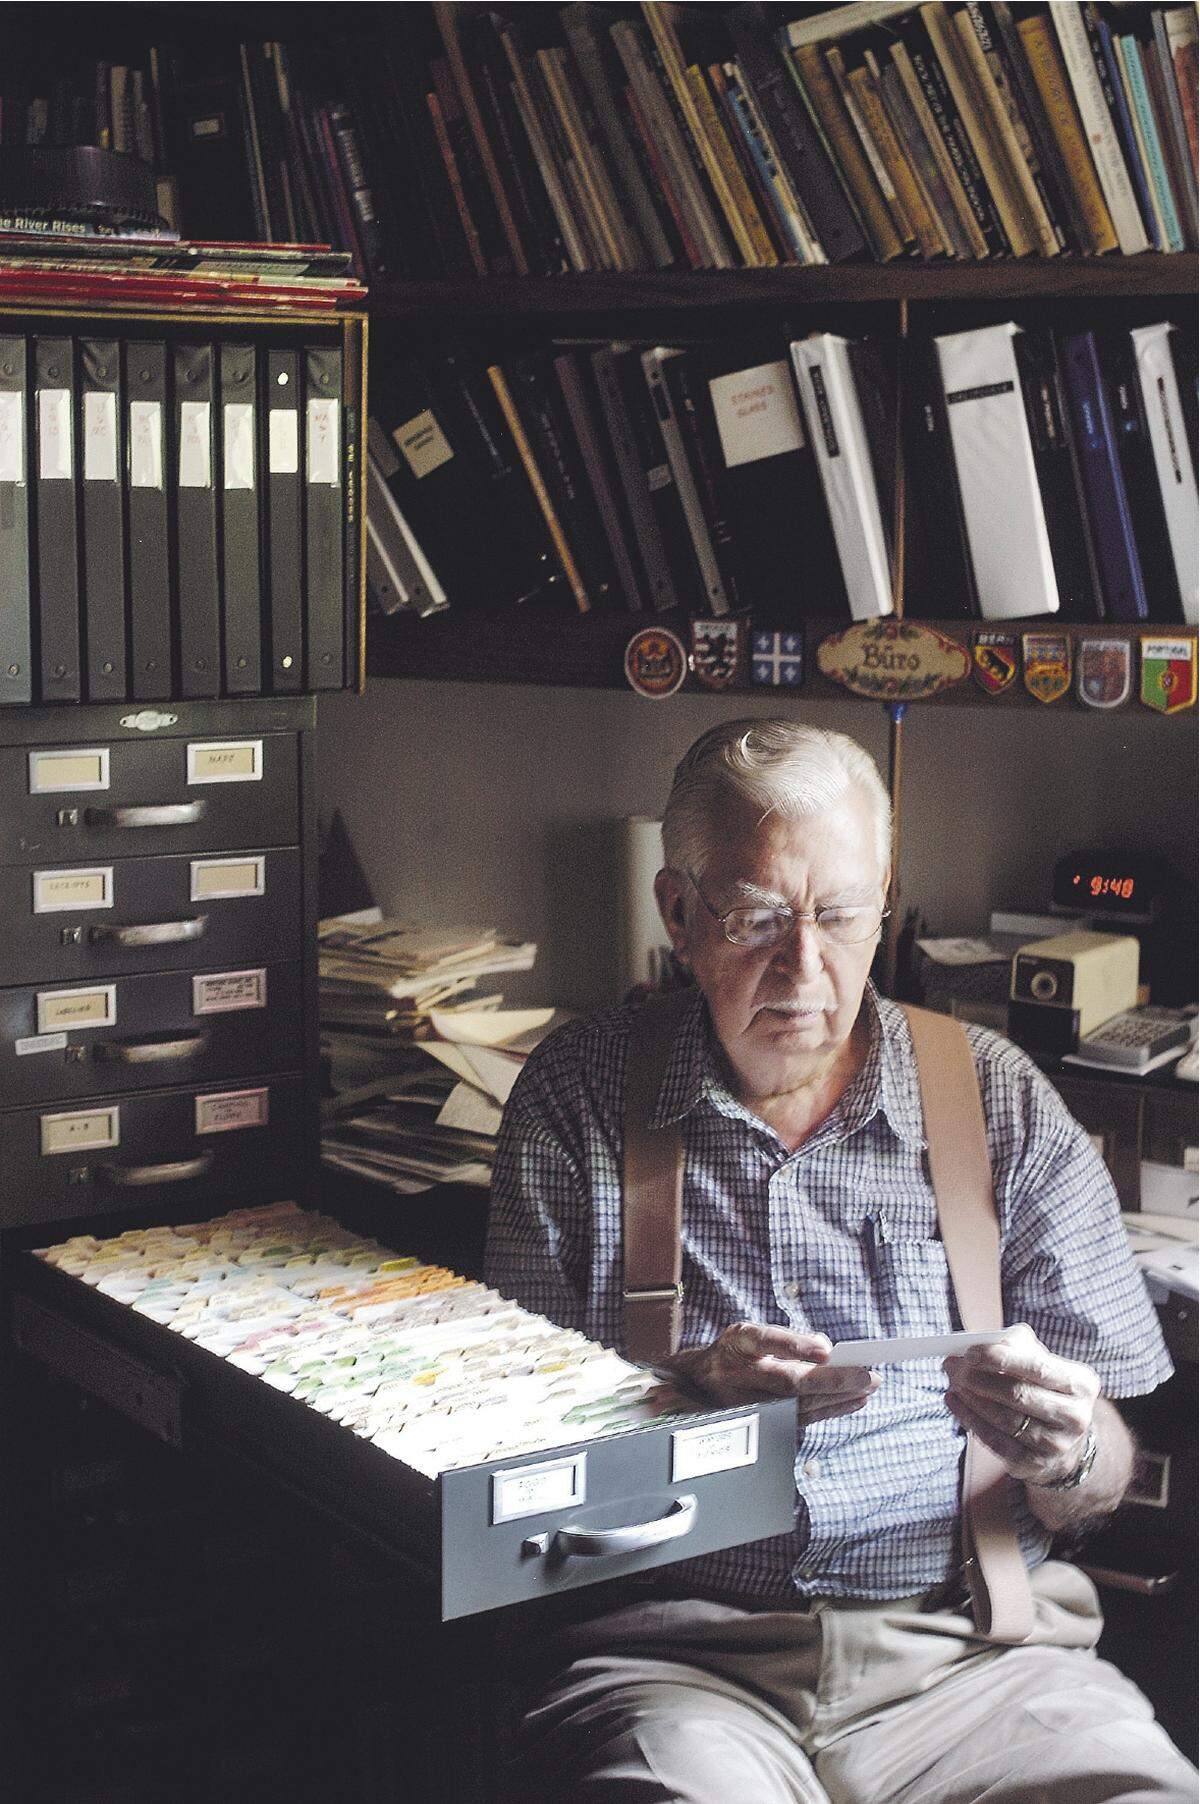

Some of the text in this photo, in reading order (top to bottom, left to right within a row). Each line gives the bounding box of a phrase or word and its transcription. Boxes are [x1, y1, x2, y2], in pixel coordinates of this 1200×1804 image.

[15, 216, 49, 231] River
[52, 222, 86, 234] Rises
[861, 643, 921, 671] Büro
[1090, 875, 1134, 899] 9:40
